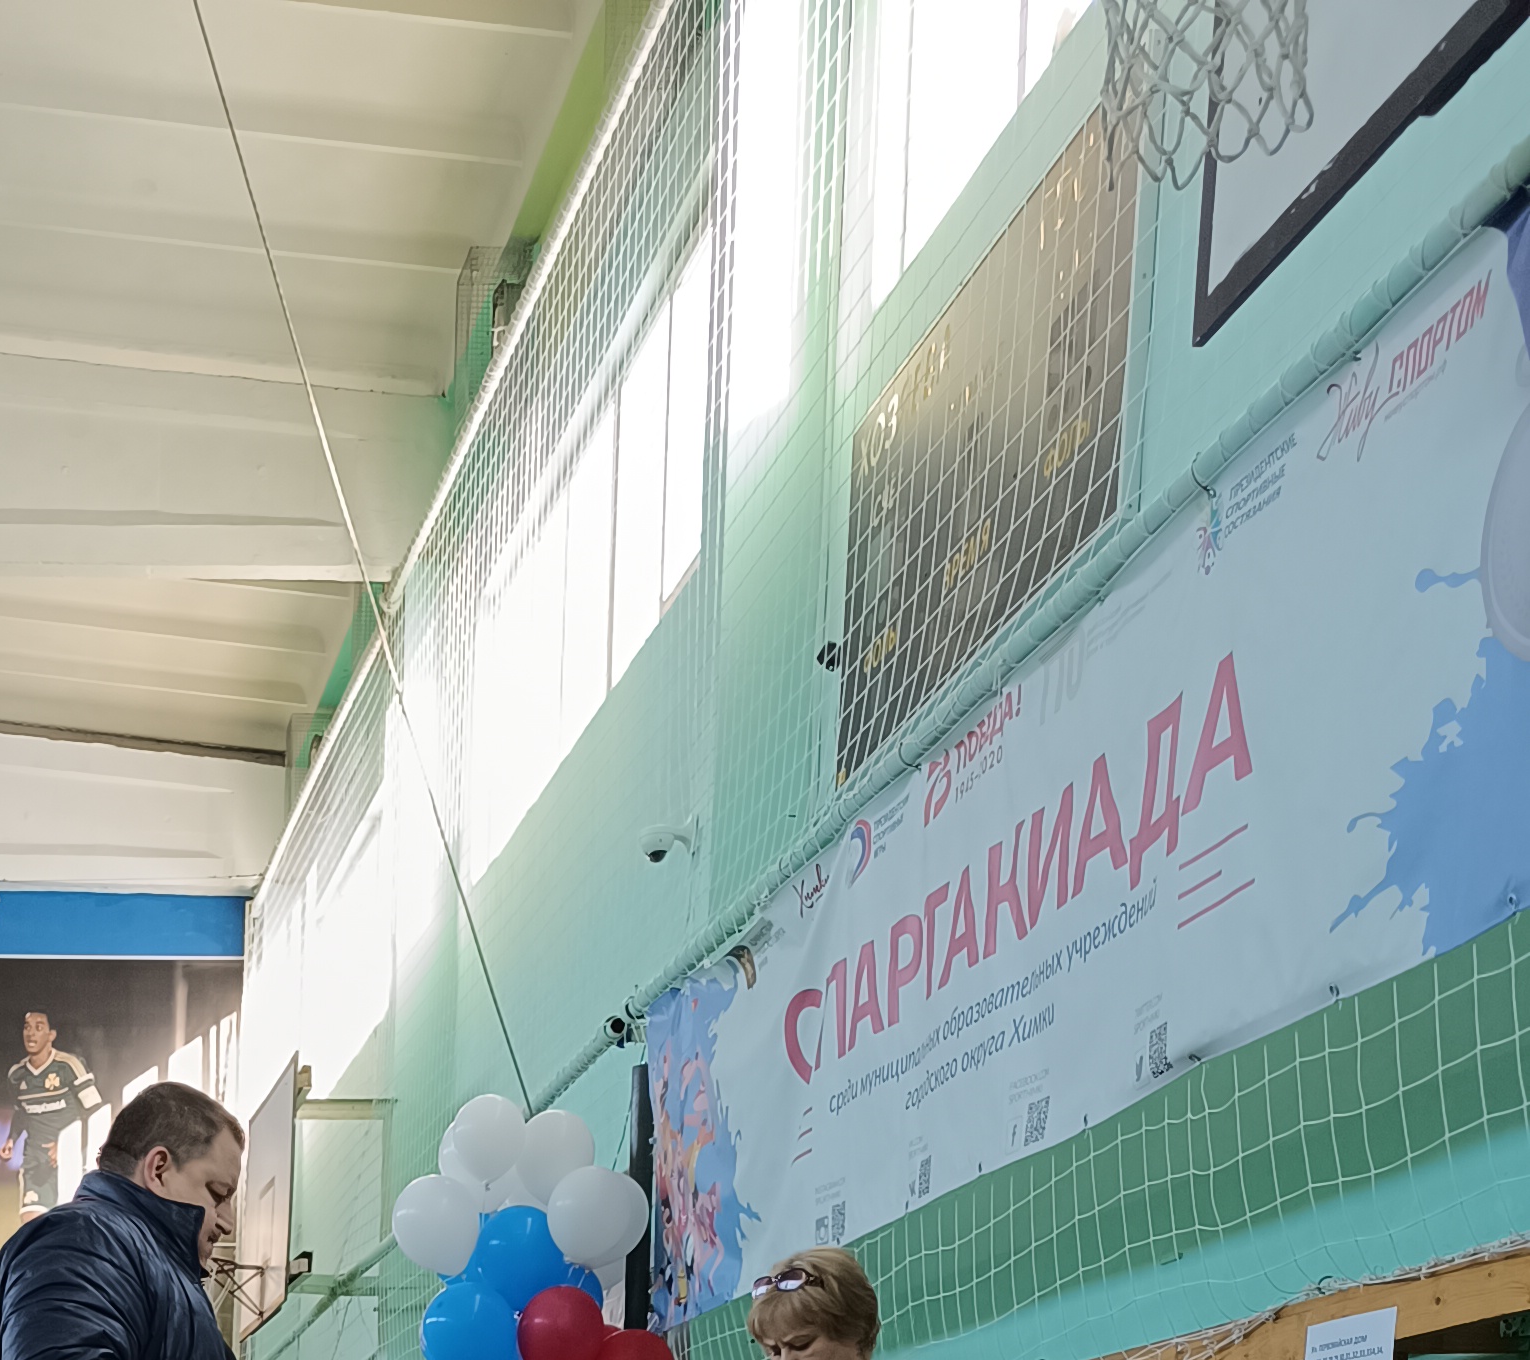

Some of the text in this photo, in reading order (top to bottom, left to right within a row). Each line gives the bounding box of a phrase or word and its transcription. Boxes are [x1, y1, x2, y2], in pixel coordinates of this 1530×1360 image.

[784, 651, 1253, 1084] СПАРТАКИАДА
[1066, 876, 1159, 973] учреждений
[961, 1029, 1004, 1073] округа
[1008, 1002, 1055, 1047] Химки
